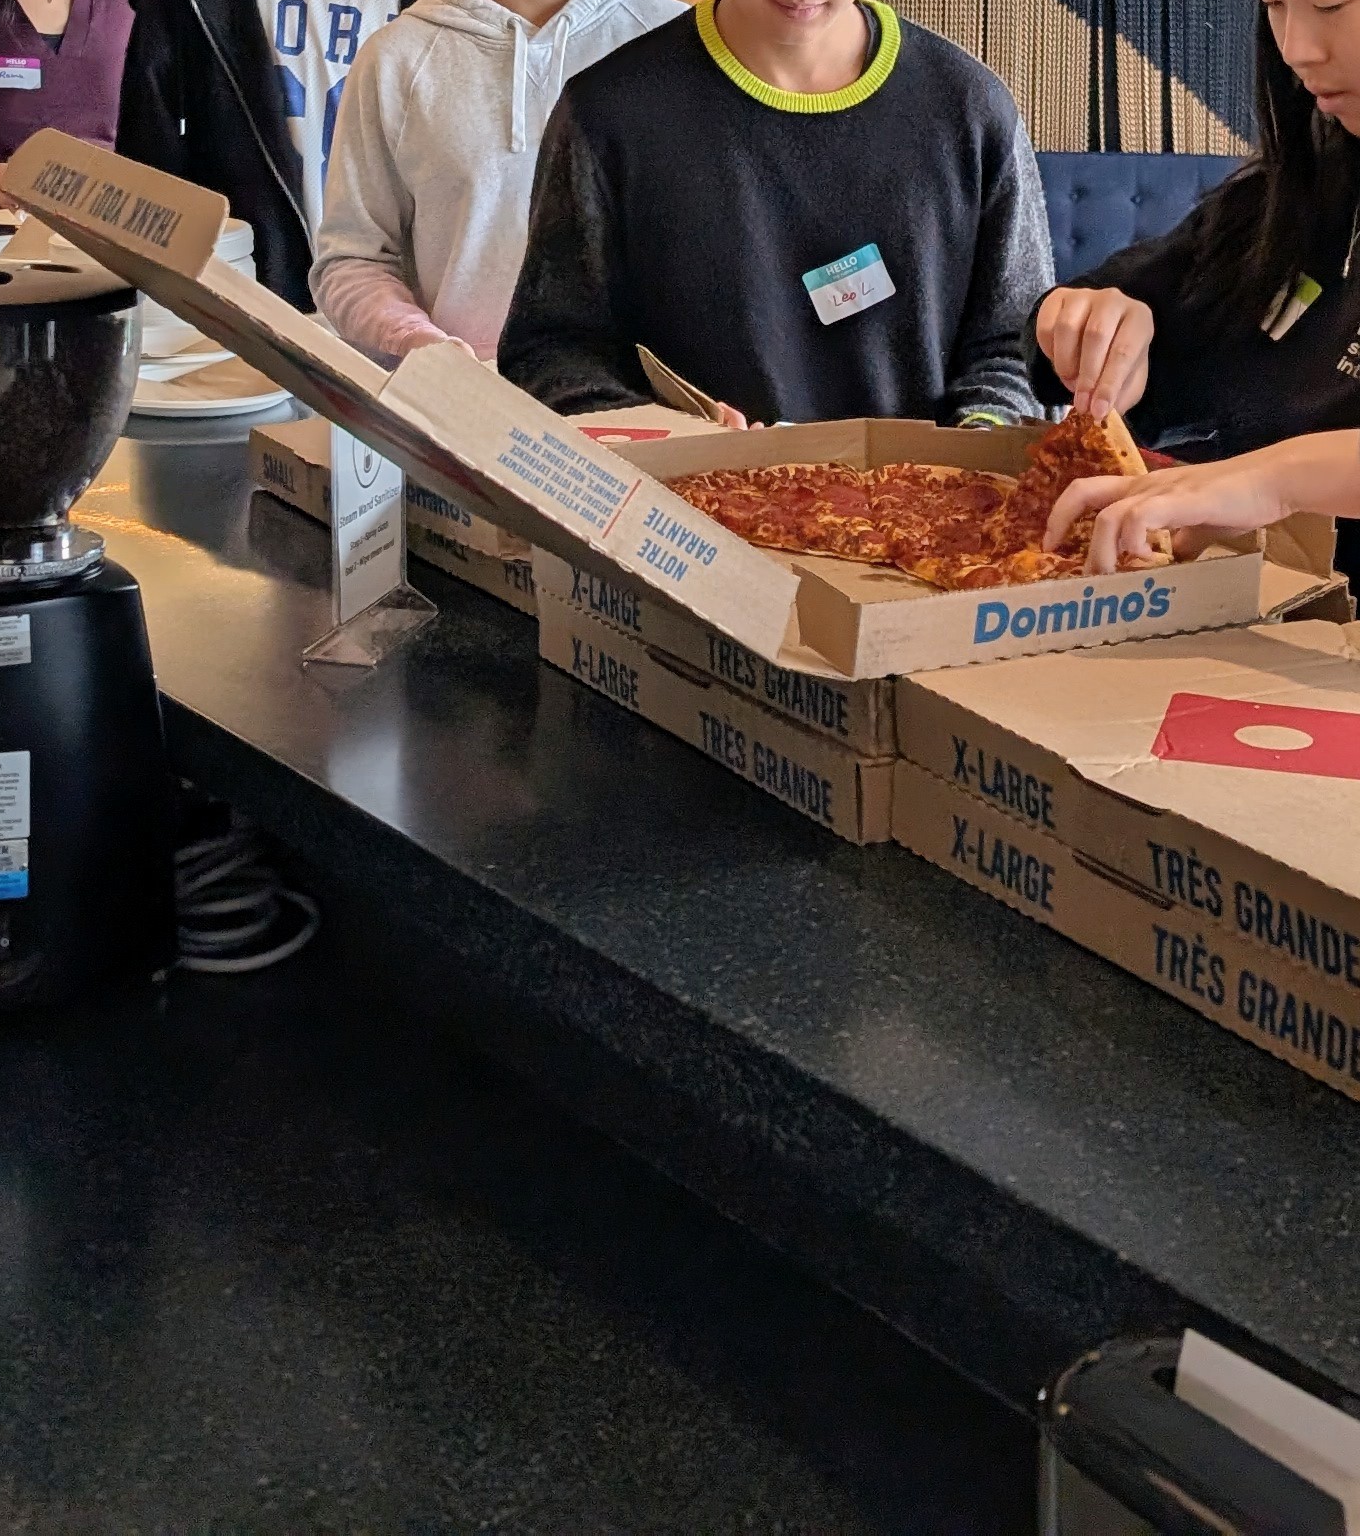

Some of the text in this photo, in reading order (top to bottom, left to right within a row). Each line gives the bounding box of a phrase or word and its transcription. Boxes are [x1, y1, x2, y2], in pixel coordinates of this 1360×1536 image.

[825, 256, 858, 276] HELLO
[833, 292, 857, 307] Leo
[635, 536, 689, 582] NOTRE
[642, 506, 718, 567] GARANTIE
[974, 577, 1171, 644] Domino's
[571, 565, 642, 632] X-LARGE
[764, 663, 848, 737] GRANDE
[571, 637, 640, 709] X-LARGE
[753, 741, 834, 824] GRANDE
[952, 734, 1056, 831] X-LARGE
[1147, 839, 1223, 918] TRÈS
[951, 814, 1056, 913] X-LARGE
[1153, 924, 1226, 1006] TRÈS
